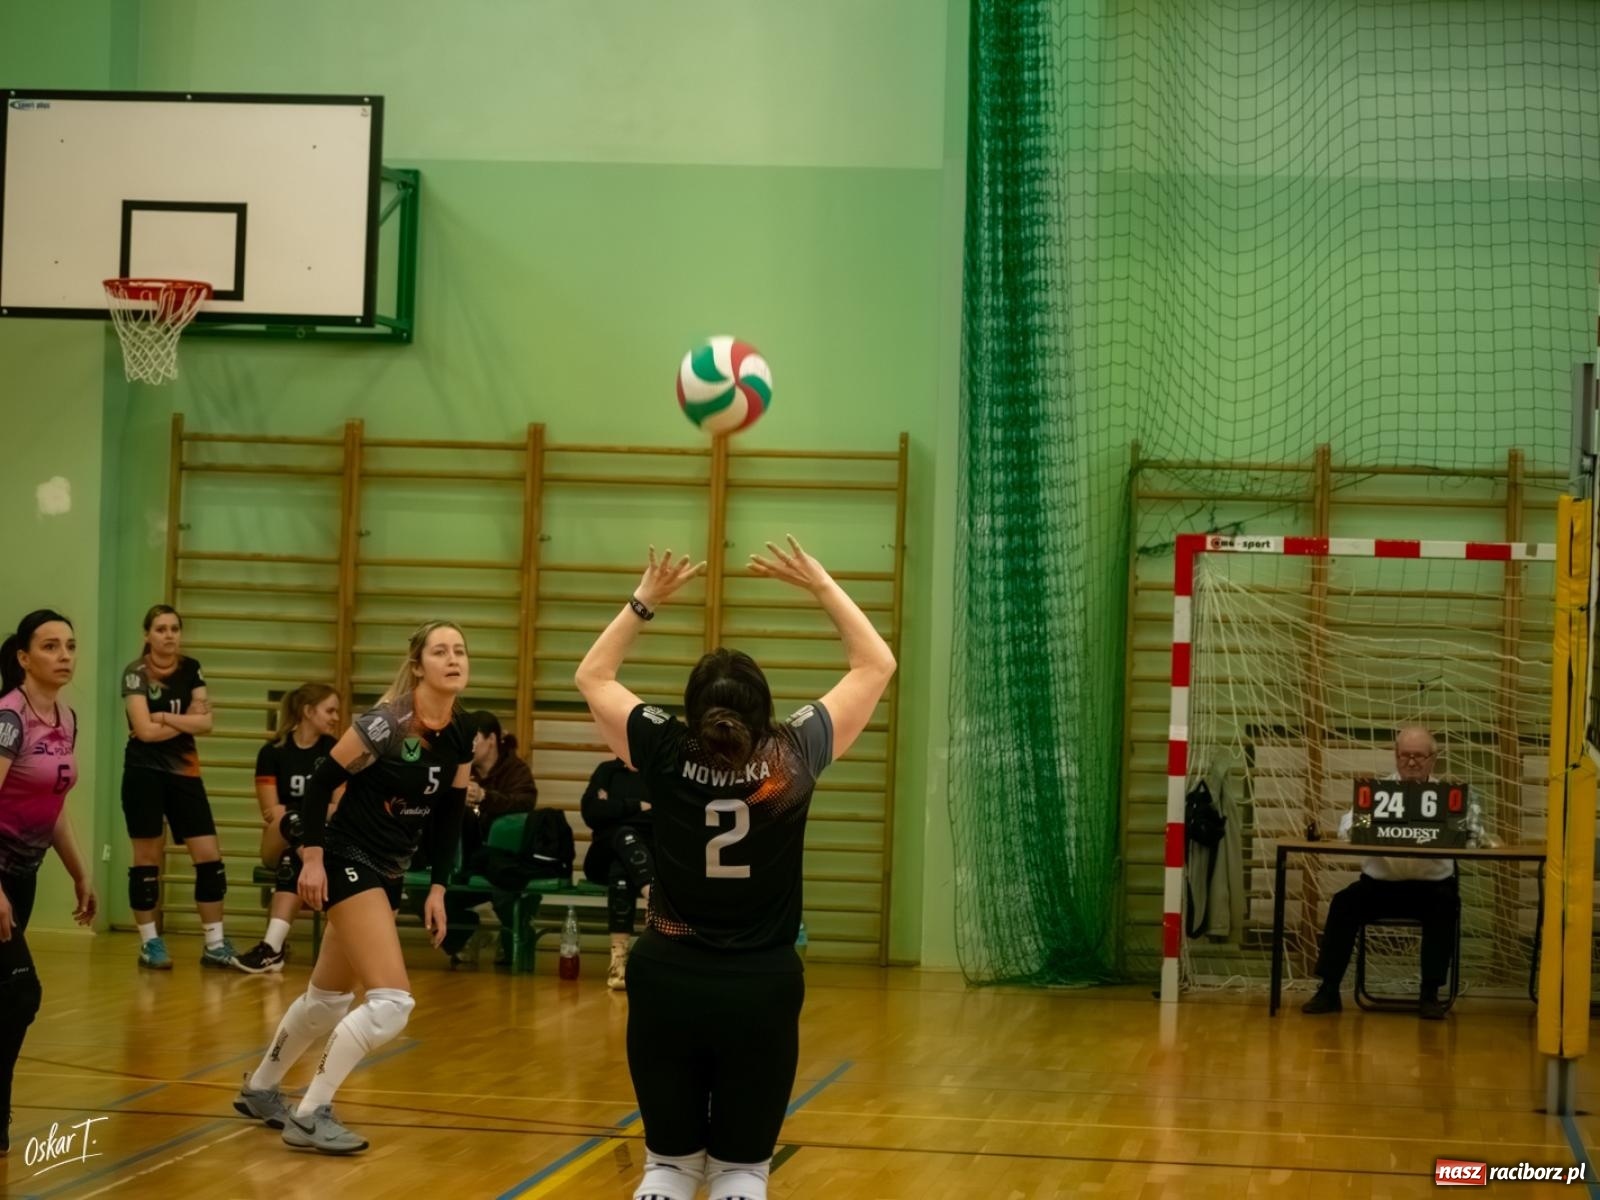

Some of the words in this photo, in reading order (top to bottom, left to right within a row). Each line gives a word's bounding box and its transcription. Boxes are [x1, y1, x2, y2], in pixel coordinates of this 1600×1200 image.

[1243, 540, 1271, 549] sport
[53, 764, 71, 795] 6
[290, 775, 313, 797] 9
[424, 766, 441, 795] 5
[1358, 786, 1371, 809] 0
[1373, 791, 1405, 819] 24
[1421, 790, 1438, 818] 6
[1448, 788, 1463, 813] 0
[705, 799, 751, 878] 2
[1376, 826, 1440, 840] MODEST
[344, 866, 359, 883] 5
